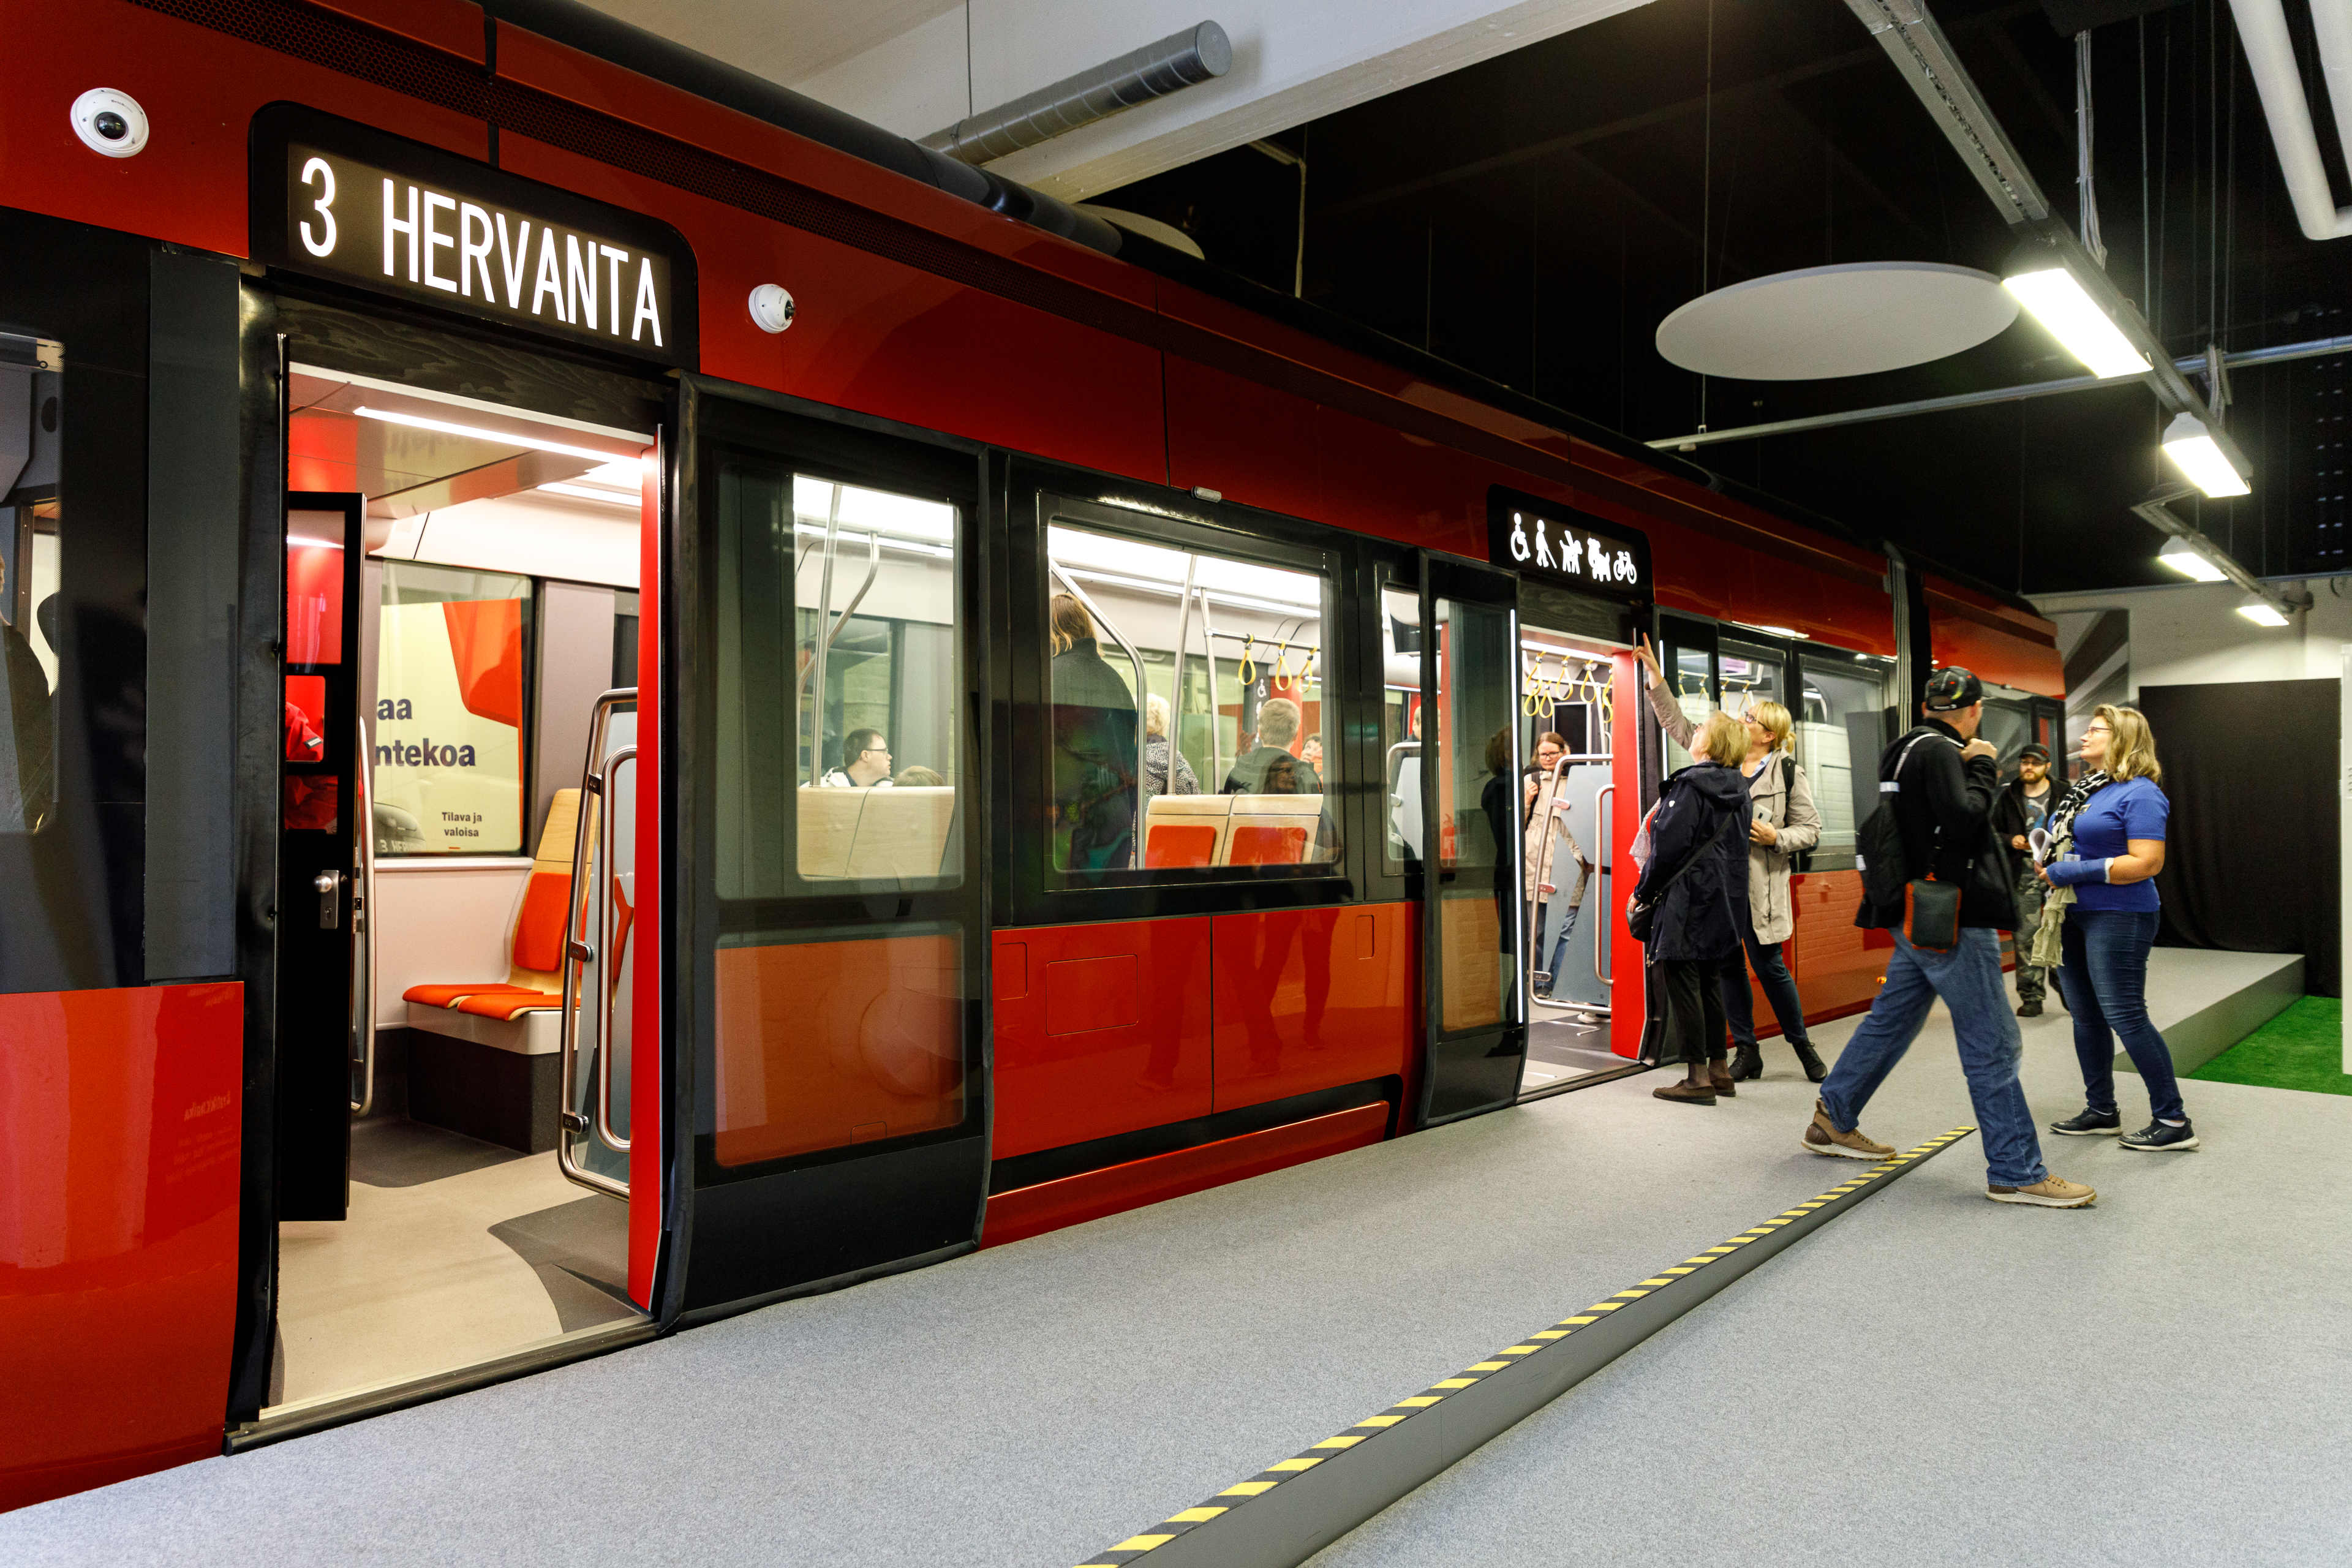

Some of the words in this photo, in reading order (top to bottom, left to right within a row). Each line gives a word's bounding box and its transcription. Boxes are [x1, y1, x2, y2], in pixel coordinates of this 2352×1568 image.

[300, 157, 337, 257] 3
[383, 178, 663, 347] HERVANTA
[442, 812, 470, 821] Tilava
[473, 812, 482, 824] ja
[444, 827, 479, 837] valoisa
[380, 839, 388, 853] 3
